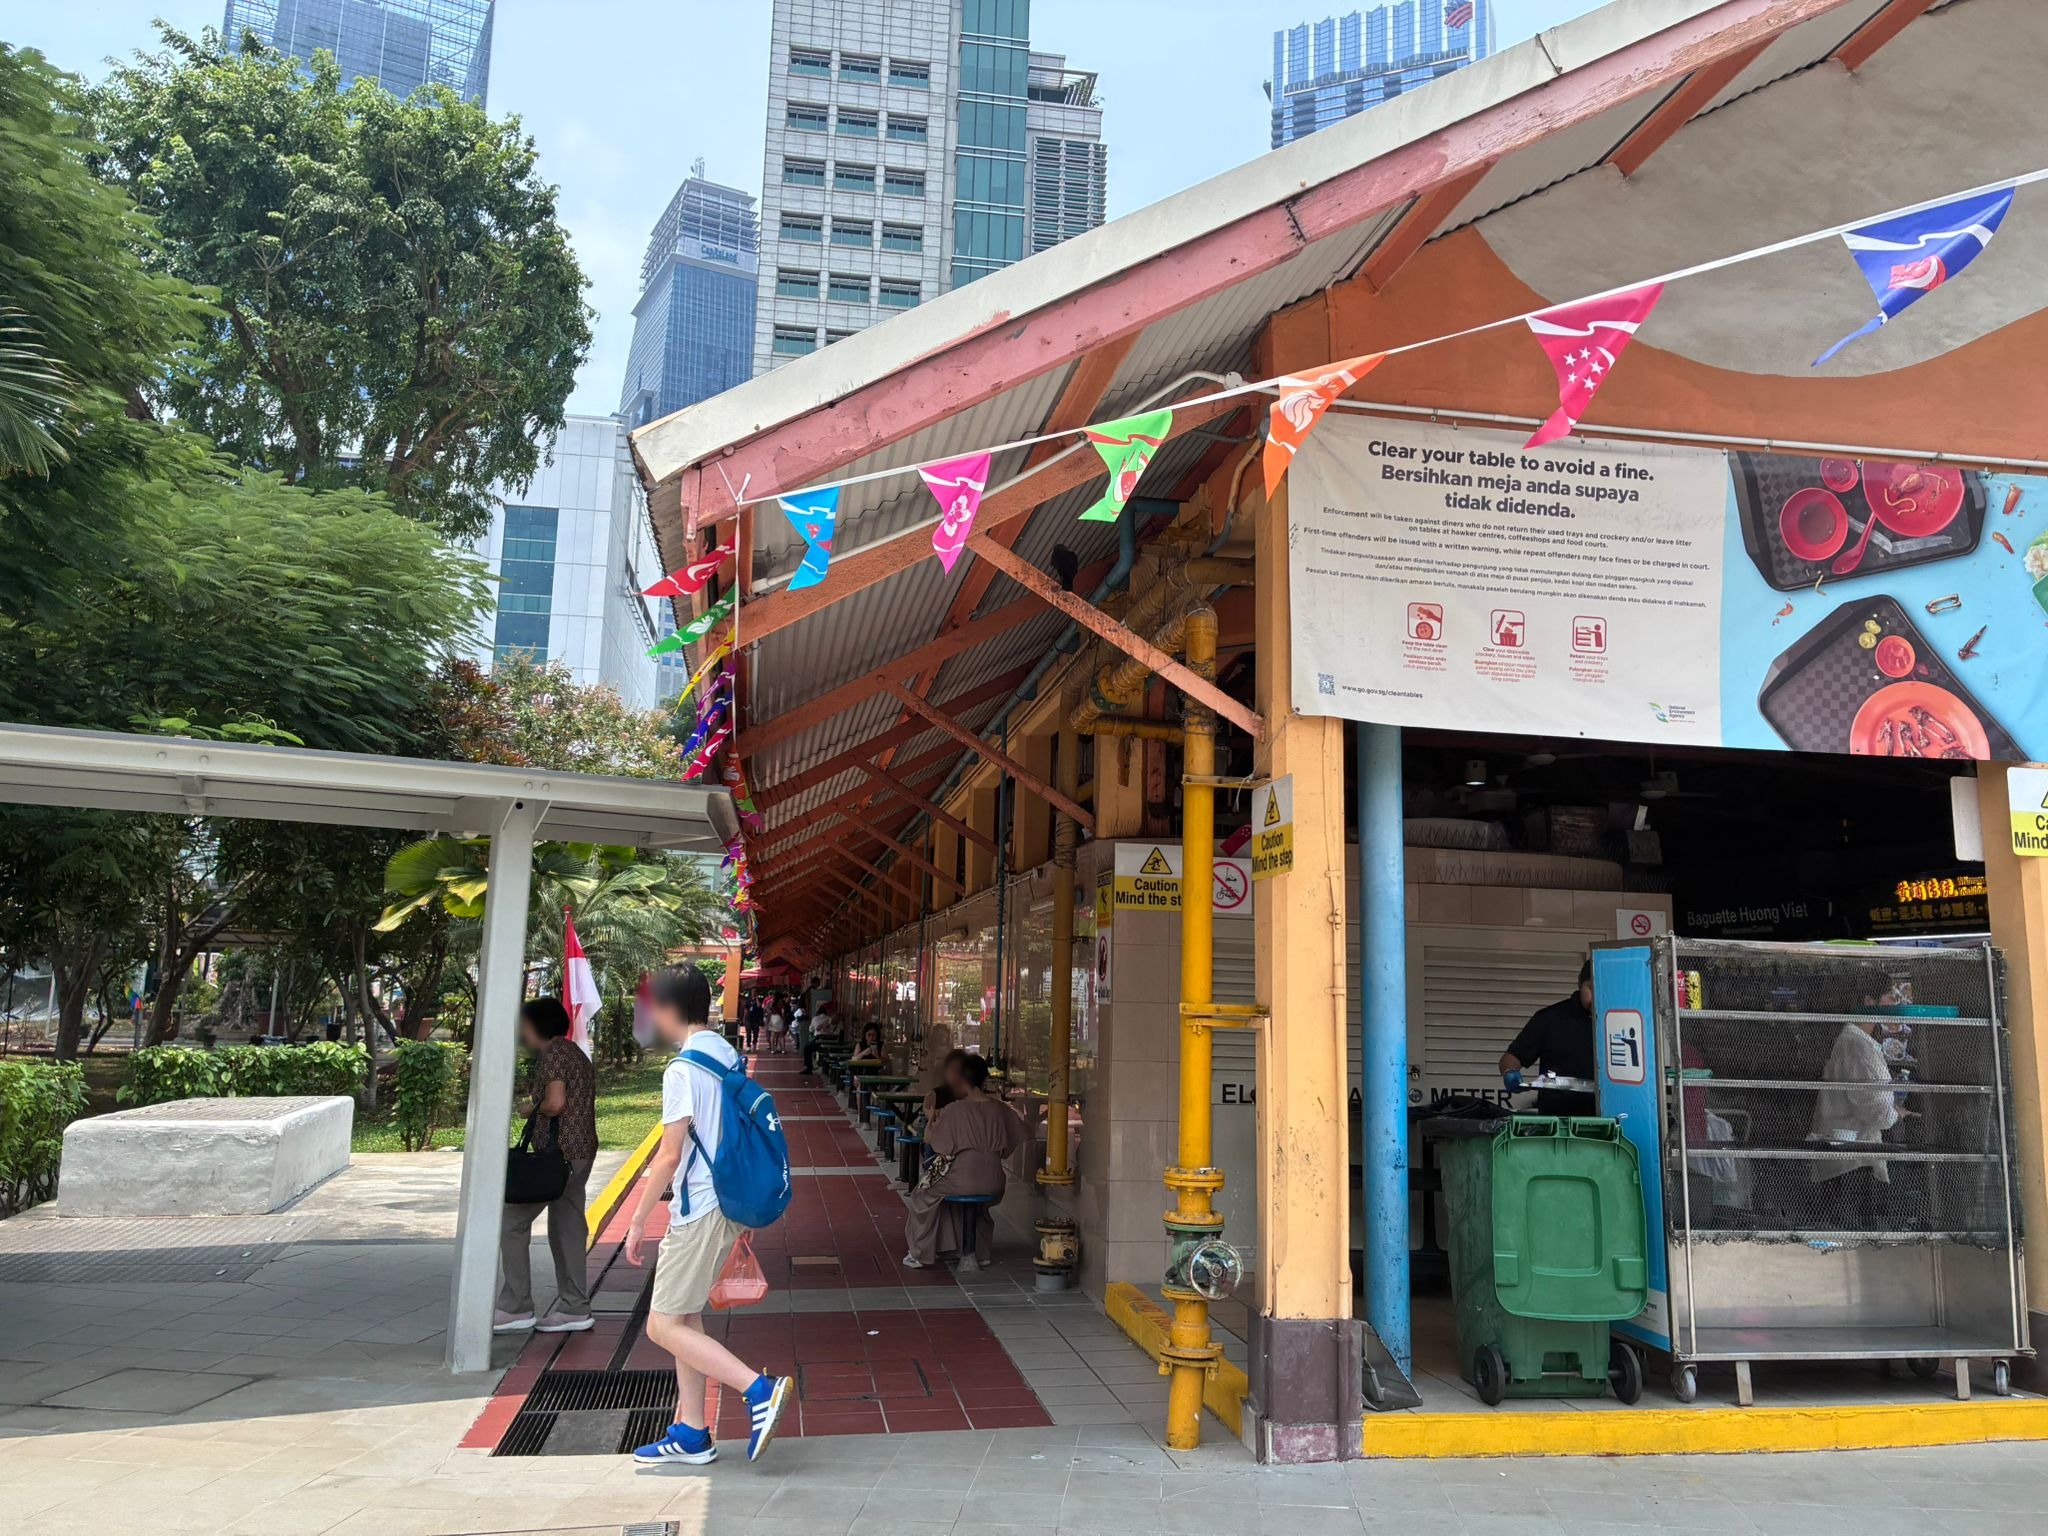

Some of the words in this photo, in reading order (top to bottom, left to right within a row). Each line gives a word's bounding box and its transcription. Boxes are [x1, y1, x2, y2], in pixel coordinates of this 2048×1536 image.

[1368, 440, 1417, 459] Clear
[1421, 448, 1465, 464] your
[1469, 450, 1515, 468] table
[1520, 455, 1539, 470] to
[1544, 458, 1595, 475] avoid
[1599, 465, 1610, 477] a
[1615, 462, 1654, 481] fine.
[1381, 464, 1473, 487] Bersihkan
[1477, 474, 1521, 494] meja
[1526, 480, 1571, 496] anda
[1575, 484, 1639, 504] supaya
[1445, 491, 1492, 511] tidak
[1496, 497, 1575, 519] didenda.
[1322, 506, 1368, 517] Enforcement
[1393, 514, 1413, 522] taken
[1414, 516, 1439, 526] against
[1441, 518, 1463, 527] diners
[1506, 524, 1528, 532] return
[1547, 528, 1564, 536] used
[1566, 529, 1583, 539] trays
[1599, 532, 1629, 542] crockery
[1631, 534, 1654, 543] and/or
[1655, 536, 1673, 544] leave
[1419, 525, 1440, 533] tables
[1450, 528, 1476, 536] hawker
[1478, 530, 1506, 541] centres,
[1507, 533, 1550, 544] coffeeshops
[1584, 539, 1608, 548] courts.
[1303, 526, 1336, 536] First-time
[1338, 530, 1371, 540] offenders
[1373, 534, 1386, 542] will
[1398, 537, 1420, 545] issued
[1444, 541, 1469, 550] written
[1470, 544, 1501, 554] warning,
[1503, 546, 1521, 554] while
[1523, 548, 1545, 558] repeat
[1547, 550, 1580, 559] offenders
[1652, 558, 1680, 569] charged
[1689, 562, 1709, 570] court.
[1341, 684, 1423, 699] www.go.gov.sg/cleantables
[1261, 831, 1284, 851] Caution
[1252, 853, 1267, 873] Mind
[1268, 851, 1278, 869] the
[1280, 848, 1293, 868] step
[1134, 878, 1178, 892] Caution
[1116, 891, 1144, 904] Mind
[1148, 893, 1167, 905] the
[1170, 894, 1182, 906] st
[1688, 909, 1737, 928] Baguette
[1739, 906, 1780, 924] Huong
[1782, 902, 1809, 918] Viet
